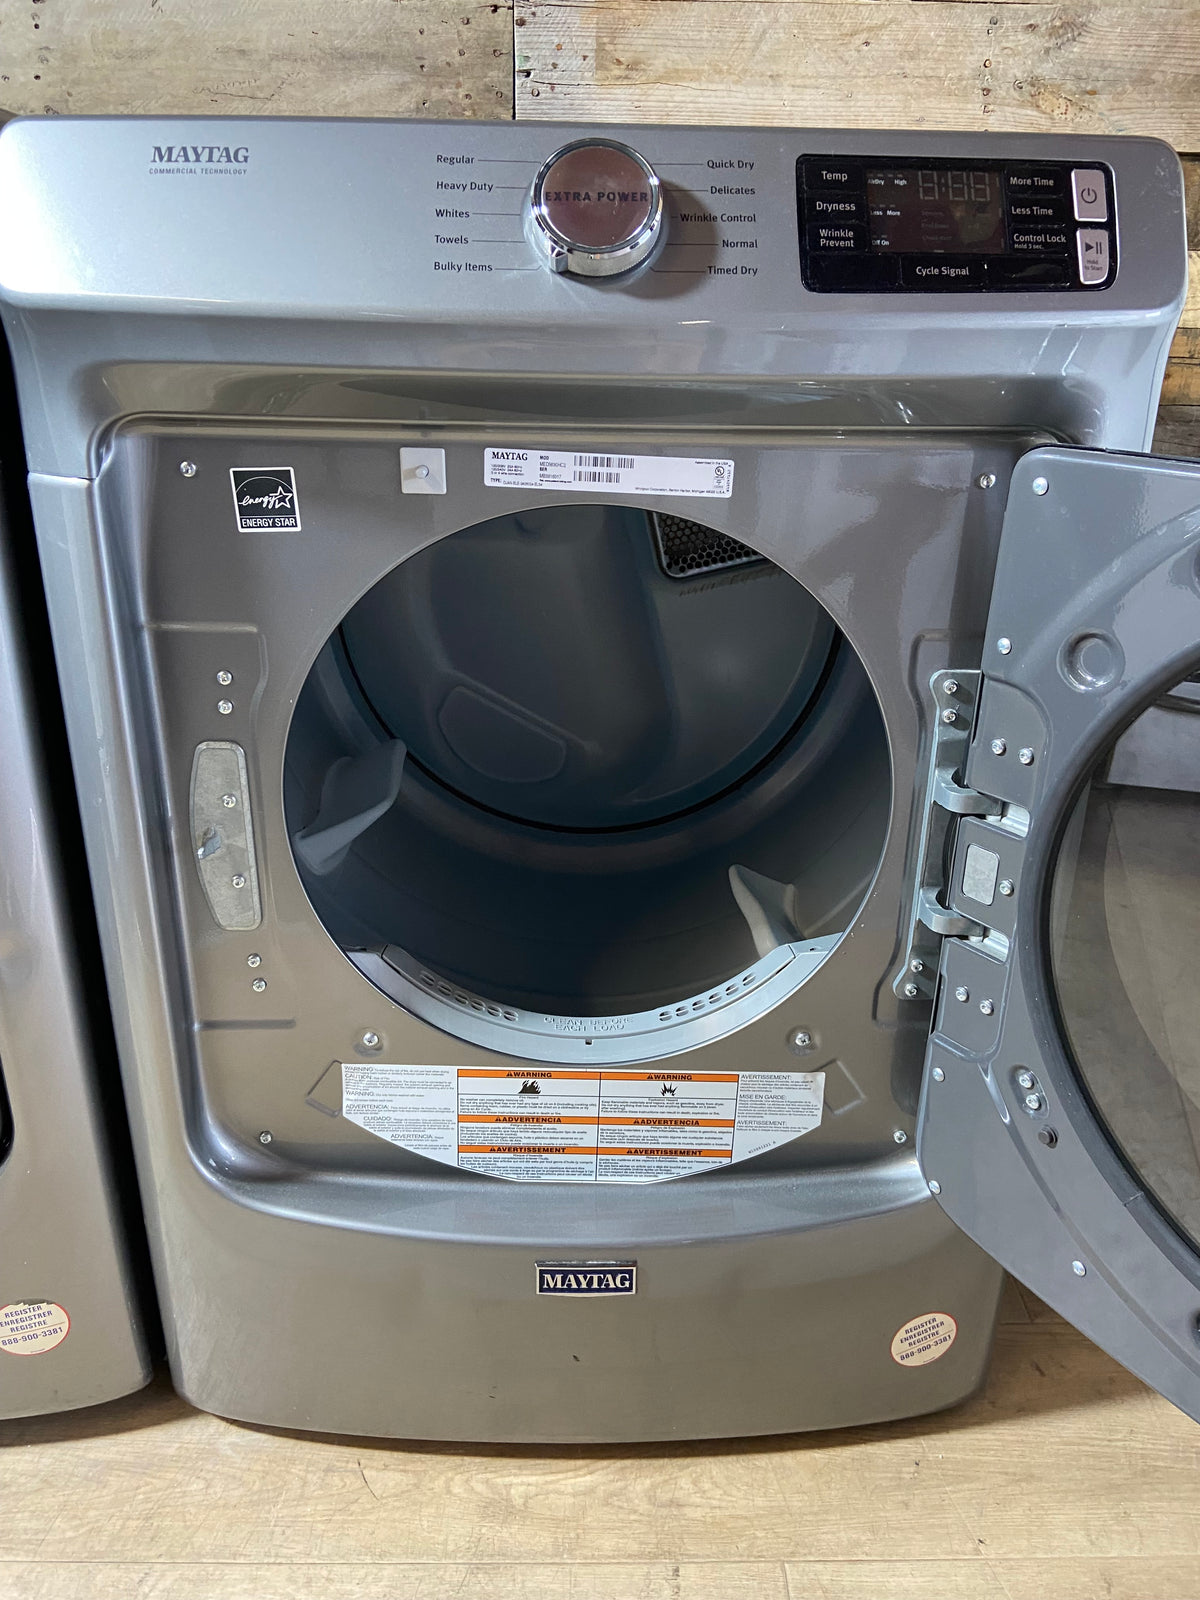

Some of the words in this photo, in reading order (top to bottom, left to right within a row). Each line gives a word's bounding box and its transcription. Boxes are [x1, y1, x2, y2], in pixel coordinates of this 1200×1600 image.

[150, 146, 250, 163] MAYTAG
[436, 155, 475, 166] Regular
[707, 160, 735, 170] Quick
[737, 160, 754, 170] Dry
[821, 171, 848, 181] Temp
[436, 181, 467, 191] Heavy
[469, 182, 494, 192] Duty
[1010, 178, 1031, 186] More
[1033, 178, 1054, 187] Time
[710, 186, 755, 195] Delicates
[545, 191, 591, 201] EXTRA
[597, 191, 648, 202] POWER
[816, 201, 856, 212] Dryness
[1011, 207, 1029, 215] Less
[1031, 207, 1053, 216] Time
[435, 209, 470, 218] Whites
[680, 214, 718, 223] Wrinkle
[721, 214, 756, 223] Control
[819, 229, 854, 238] Wrinkle
[1014, 233, 1044, 242] Control
[1046, 234, 1066, 243] Lock
[434, 235, 469, 244] Towels
[722, 239, 757, 248] Normal
[820, 238, 854, 248] Prevent
[434, 262, 463, 273] Bulky
[465, 262, 492, 271] Items
[707, 266, 738, 275] Timed
[741, 266, 758, 277] Dry
[916, 266, 939, 277] Cycle
[942, 266, 969, 277] Signal
[492, 452, 528, 461] MAYTAG
[239, 495, 282, 509] energy
[242, 518, 273, 527] ENERGY
[275, 518, 296, 527] STAR
[544, 1017, 583, 1026] CLEAN
[555, 1024, 586, 1032] EACH
[513, 1071, 552, 1079] WARNING
[542, 1273, 630, 1288] MAYTAG
[4, 1305, 42, 1318] REGISTER
[0, 1310, 52, 1327] ENREGISTRER
[10, 1319, 47, 1333] REGISTRE
[905, 1318, 937, 1334] REGISTER
[1, 1326, 63, 1346] 888-900-3381
[900, 1321, 945, 1344] ENREGISTRER
[908, 1331, 940, 1347] REGISTRE
[900, 1334, 952, 1361] 888-900-3381
